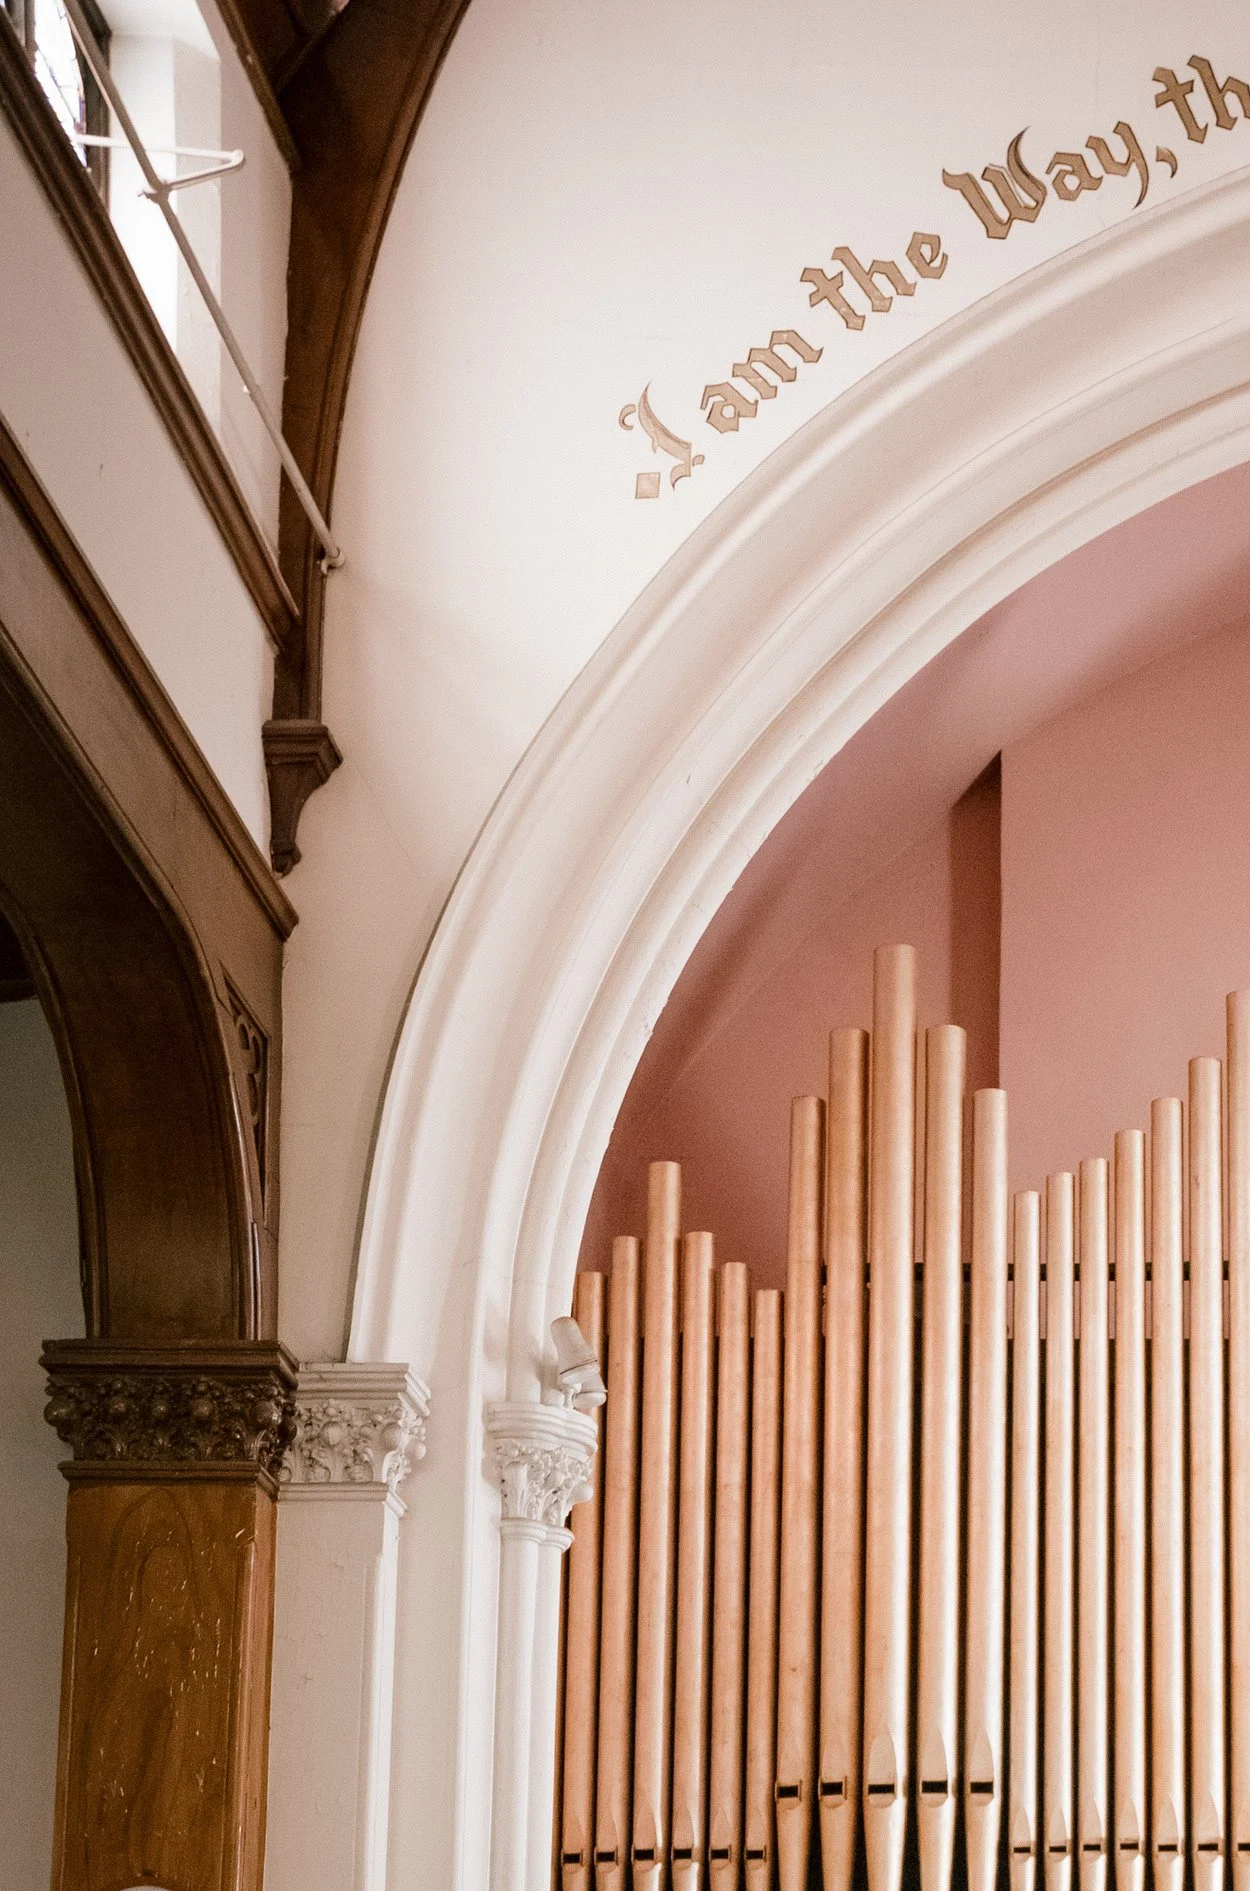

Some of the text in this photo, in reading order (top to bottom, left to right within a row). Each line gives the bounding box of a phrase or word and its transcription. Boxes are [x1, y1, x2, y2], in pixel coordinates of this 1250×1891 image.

[700, 329, 823, 434] am
[800, 231, 948, 331] the
[942, 120, 1177, 240] Way,
